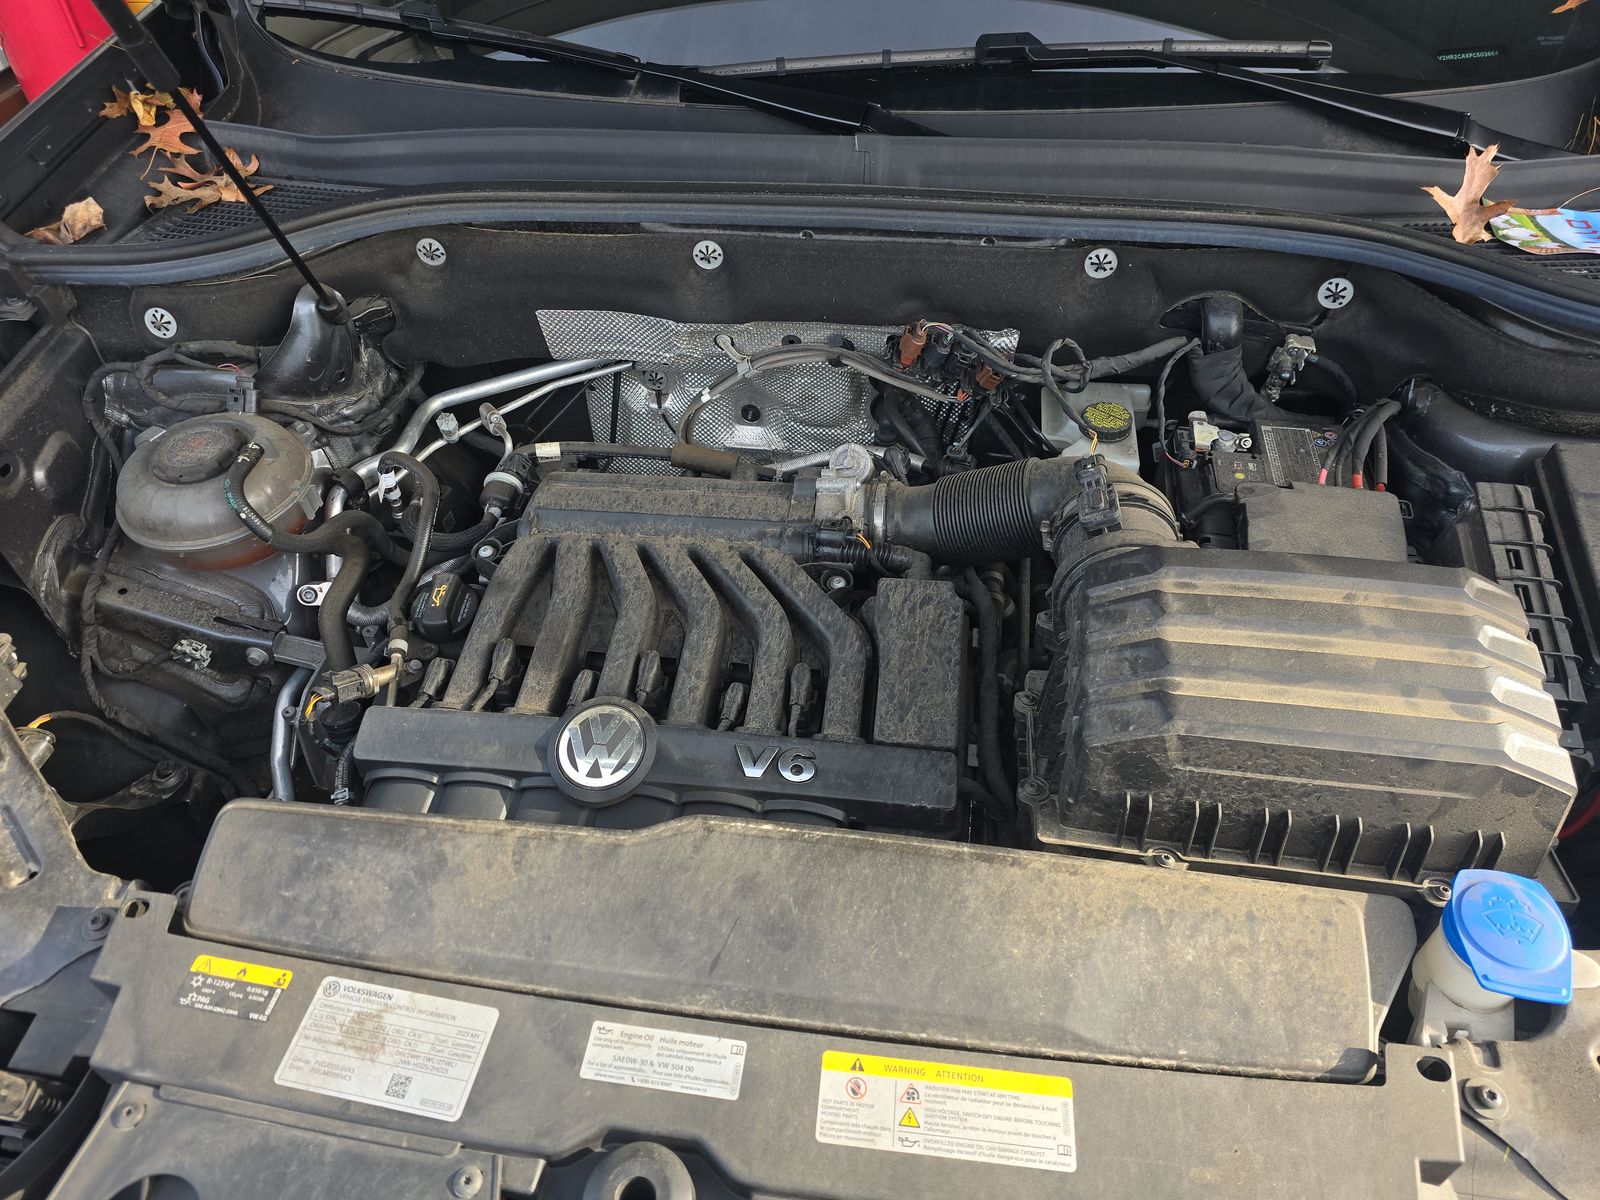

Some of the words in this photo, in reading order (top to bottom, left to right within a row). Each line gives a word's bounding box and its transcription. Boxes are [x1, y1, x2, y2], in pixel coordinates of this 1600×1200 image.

[735, 743, 816, 783] V6
[343, 985, 394, 1000] VOLKSWAGEN
[196, 996, 211, 1004] PAG
[340, 993, 362, 1002] VEHICLE
[363, 998, 389, 1007] EMISSION
[390, 1003, 416, 1013] CONTROL
[417, 1009, 458, 1021] INFORMATION
[249, 1012, 258, 1020] VW
[259, 1014, 267, 1022] AG
[620, 1031, 643, 1042] Engine
[452, 1040, 477, 1050] Gasoline
[660, 1036, 678, 1045] Huile
[679, 1040, 704, 1049] moteur
[448, 1049, 473, 1060] Gasoline
[658, 1061, 670, 1069] VW
[671, 1063, 684, 1071] 504
[685, 1065, 695, 1073] 00
[884, 1064, 926, 1076] WARNING
[936, 1070, 984, 1082] ATTENTION
[1035, 1120, 1061, 1128] TOUCHING
[923, 1138, 954, 1146] OVERFILLED
